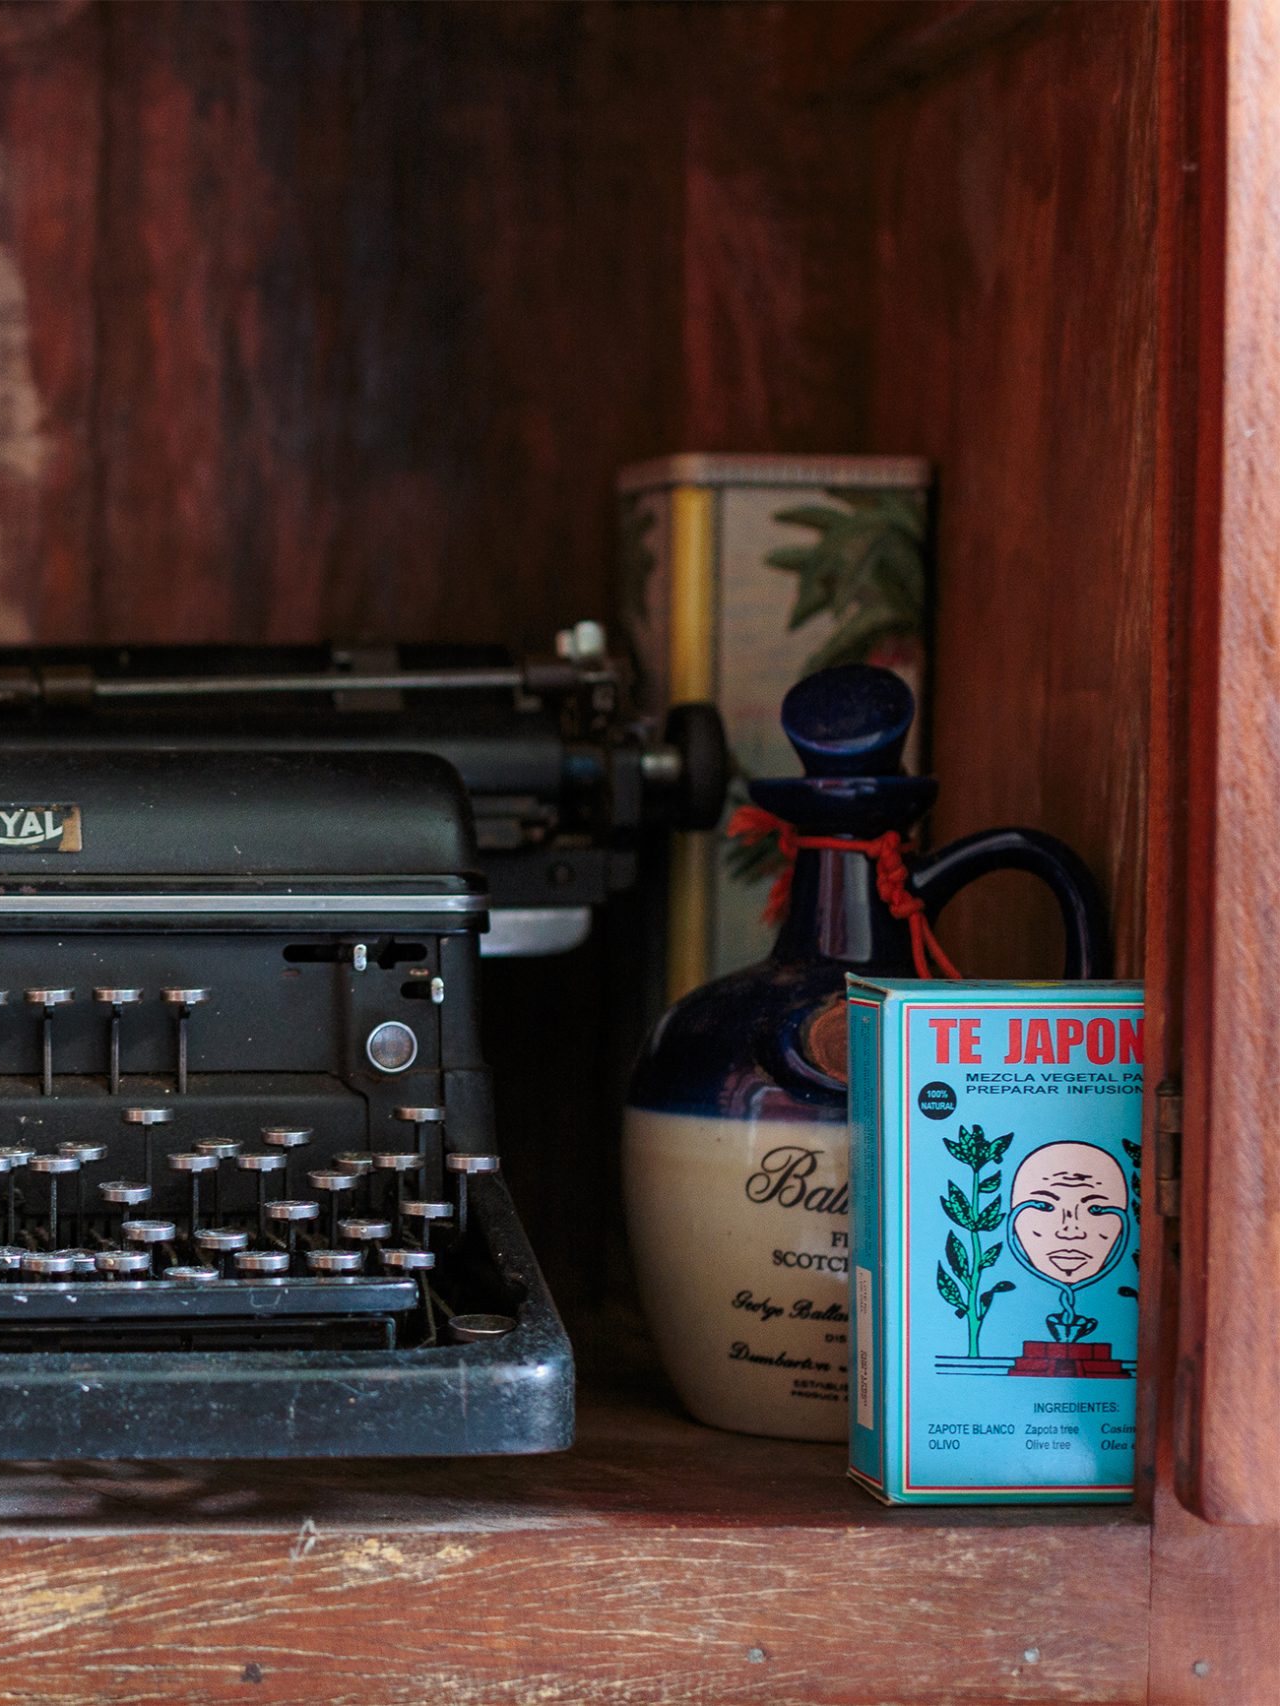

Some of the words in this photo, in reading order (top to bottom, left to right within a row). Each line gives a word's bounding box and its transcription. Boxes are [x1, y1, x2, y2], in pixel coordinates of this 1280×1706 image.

[928, 1018, 982, 1064] TE
[1004, 1018, 1144, 1065] JAPON
[966, 1073, 1034, 1082] MEZCLA
[1041, 1073, 1118, 1082] VEGETAL
[926, 1090, 949, 1099] 100%
[966, 1085, 1058, 1095] PREPARAR
[921, 1102, 955, 1110] NATURAL
[1033, 1402, 1120, 1413] INGREDIENTES:
[927, 1424, 969, 1435] ZAPOTE
[972, 1424, 1015, 1435] BLANCO
[1024, 1424, 1059, 1436] Zapota
[1060, 1425, 1080, 1435] tree
[928, 1439, 960, 1450] OLIVO
[1025, 1440, 1050, 1450] Olive
[1052, 1440, 1072, 1450] tree
[1100, 1439, 1128, 1450] Olea
